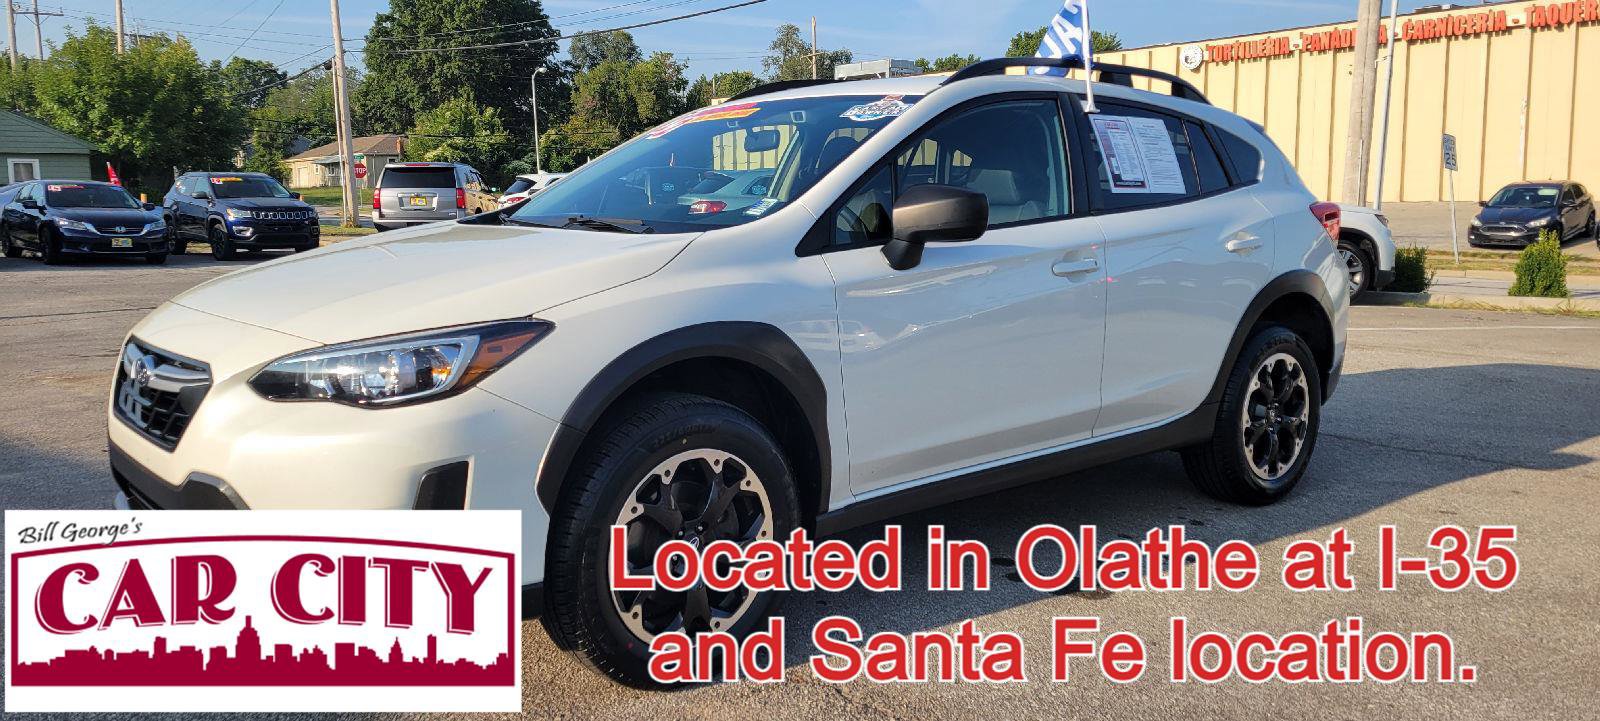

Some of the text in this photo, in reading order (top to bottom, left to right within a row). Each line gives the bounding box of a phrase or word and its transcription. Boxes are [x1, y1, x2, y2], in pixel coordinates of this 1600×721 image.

[1206, 37, 1290, 63] TORTILLERIA
[1302, 25, 1387, 52] PANADA
[1402, 10, 1507, 40] CARNICERIA
[1445, 152, 1457, 166] 25
